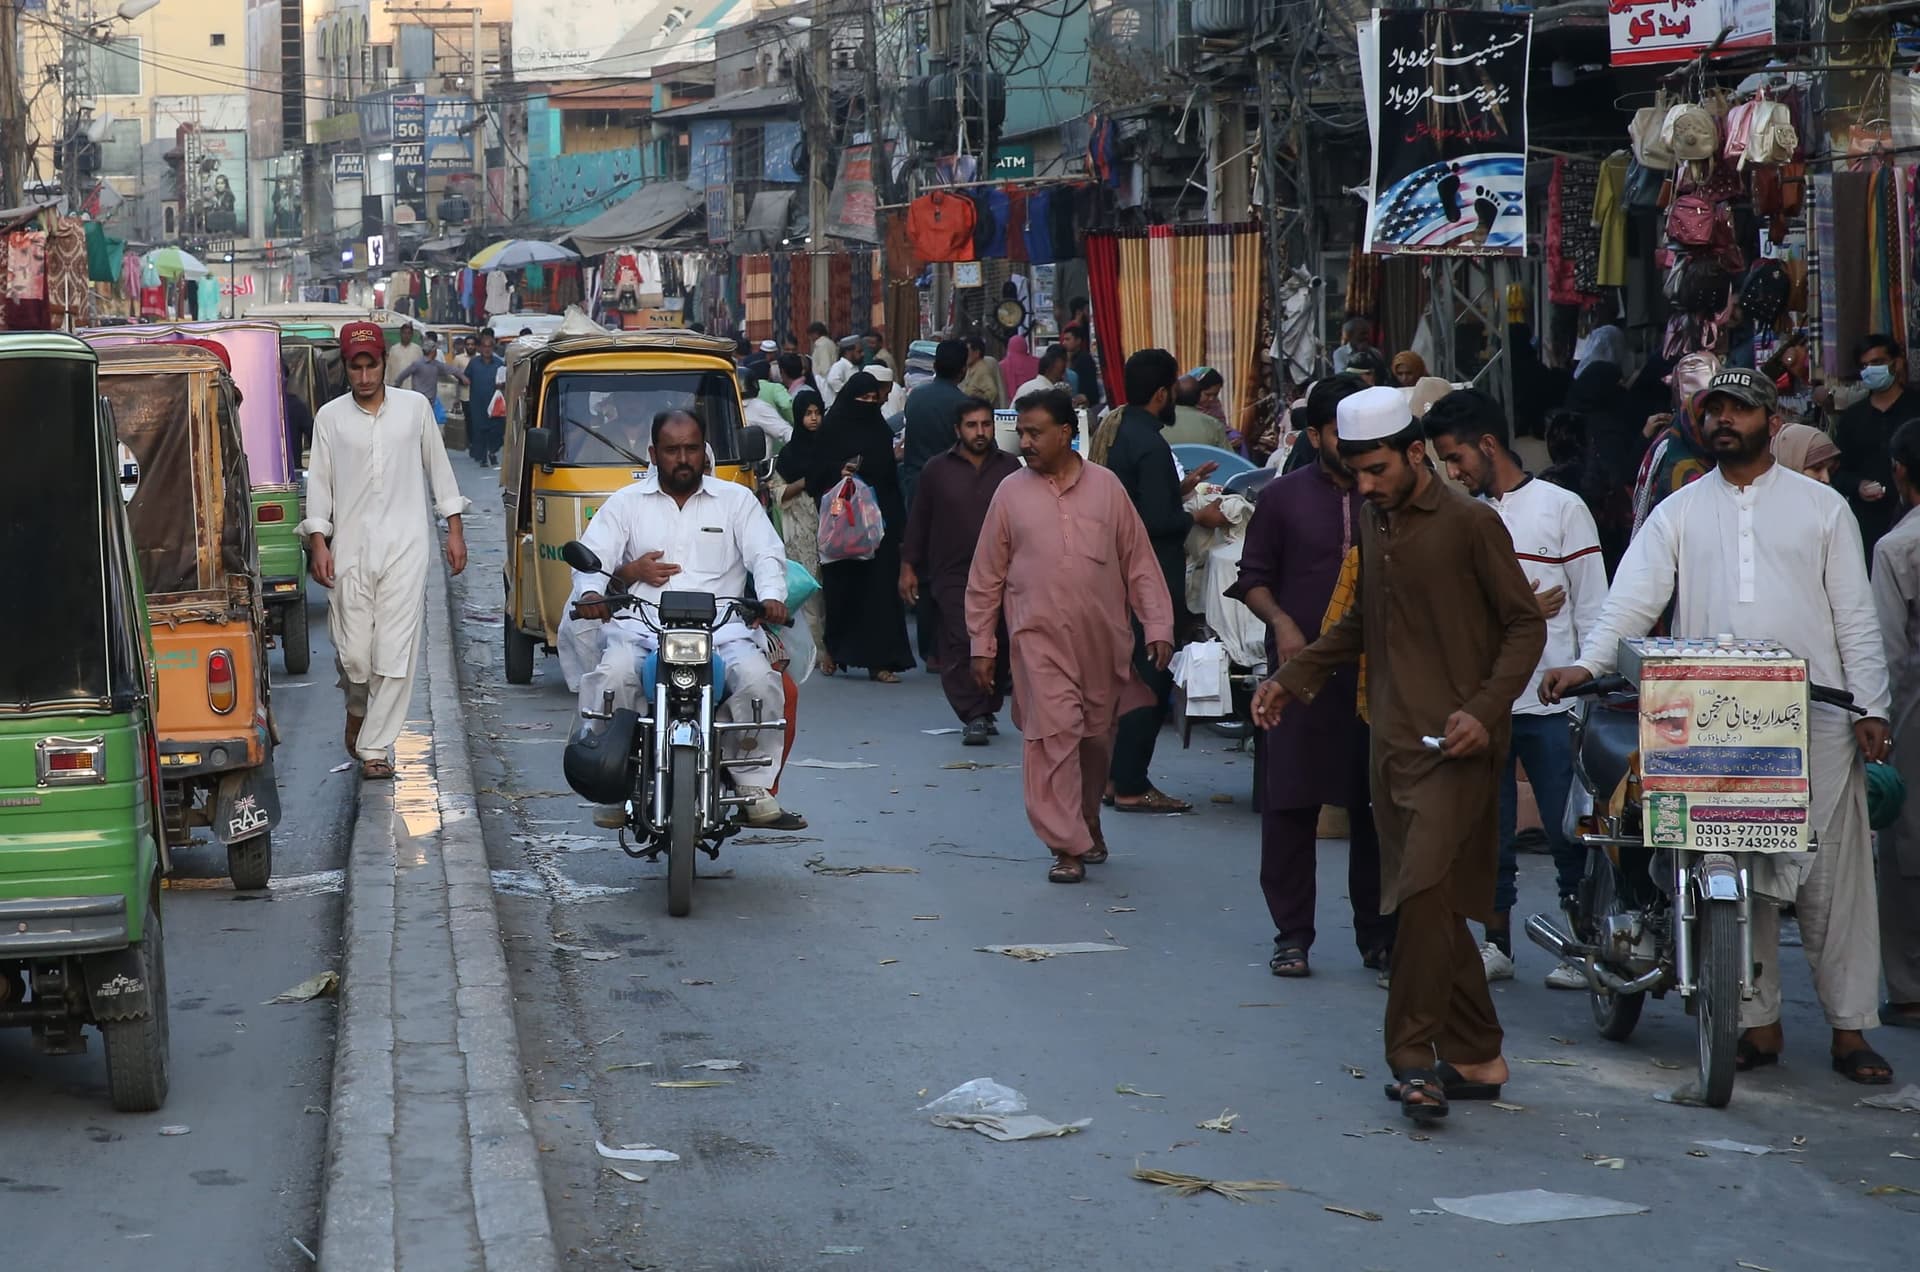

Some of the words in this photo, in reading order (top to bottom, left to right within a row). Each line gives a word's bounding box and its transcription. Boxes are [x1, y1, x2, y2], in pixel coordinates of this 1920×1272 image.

[1627, 10, 1656, 44] کو
[1406, 43, 1438, 67] زندہ
[1433, 32, 1524, 66] حسینیت
[1387, 47, 1407, 74] باد
[1384, 84, 1404, 111] باد
[1404, 85, 1434, 115] مردہ
[433, 101, 466, 118] JAN
[399, 146, 421, 156] JAN
[340, 156, 360, 165] JAN
[395, 156, 425, 166] MALL
[996, 156, 1025, 168] ATM
[337, 165, 363, 173] MALL
[1713, 373, 1752, 387] KING
[1696, 694, 1730, 729] منجن
[1696, 824, 1798, 837] 0303-9770198
[1695, 837, 1798, 849] 0313-7432966
